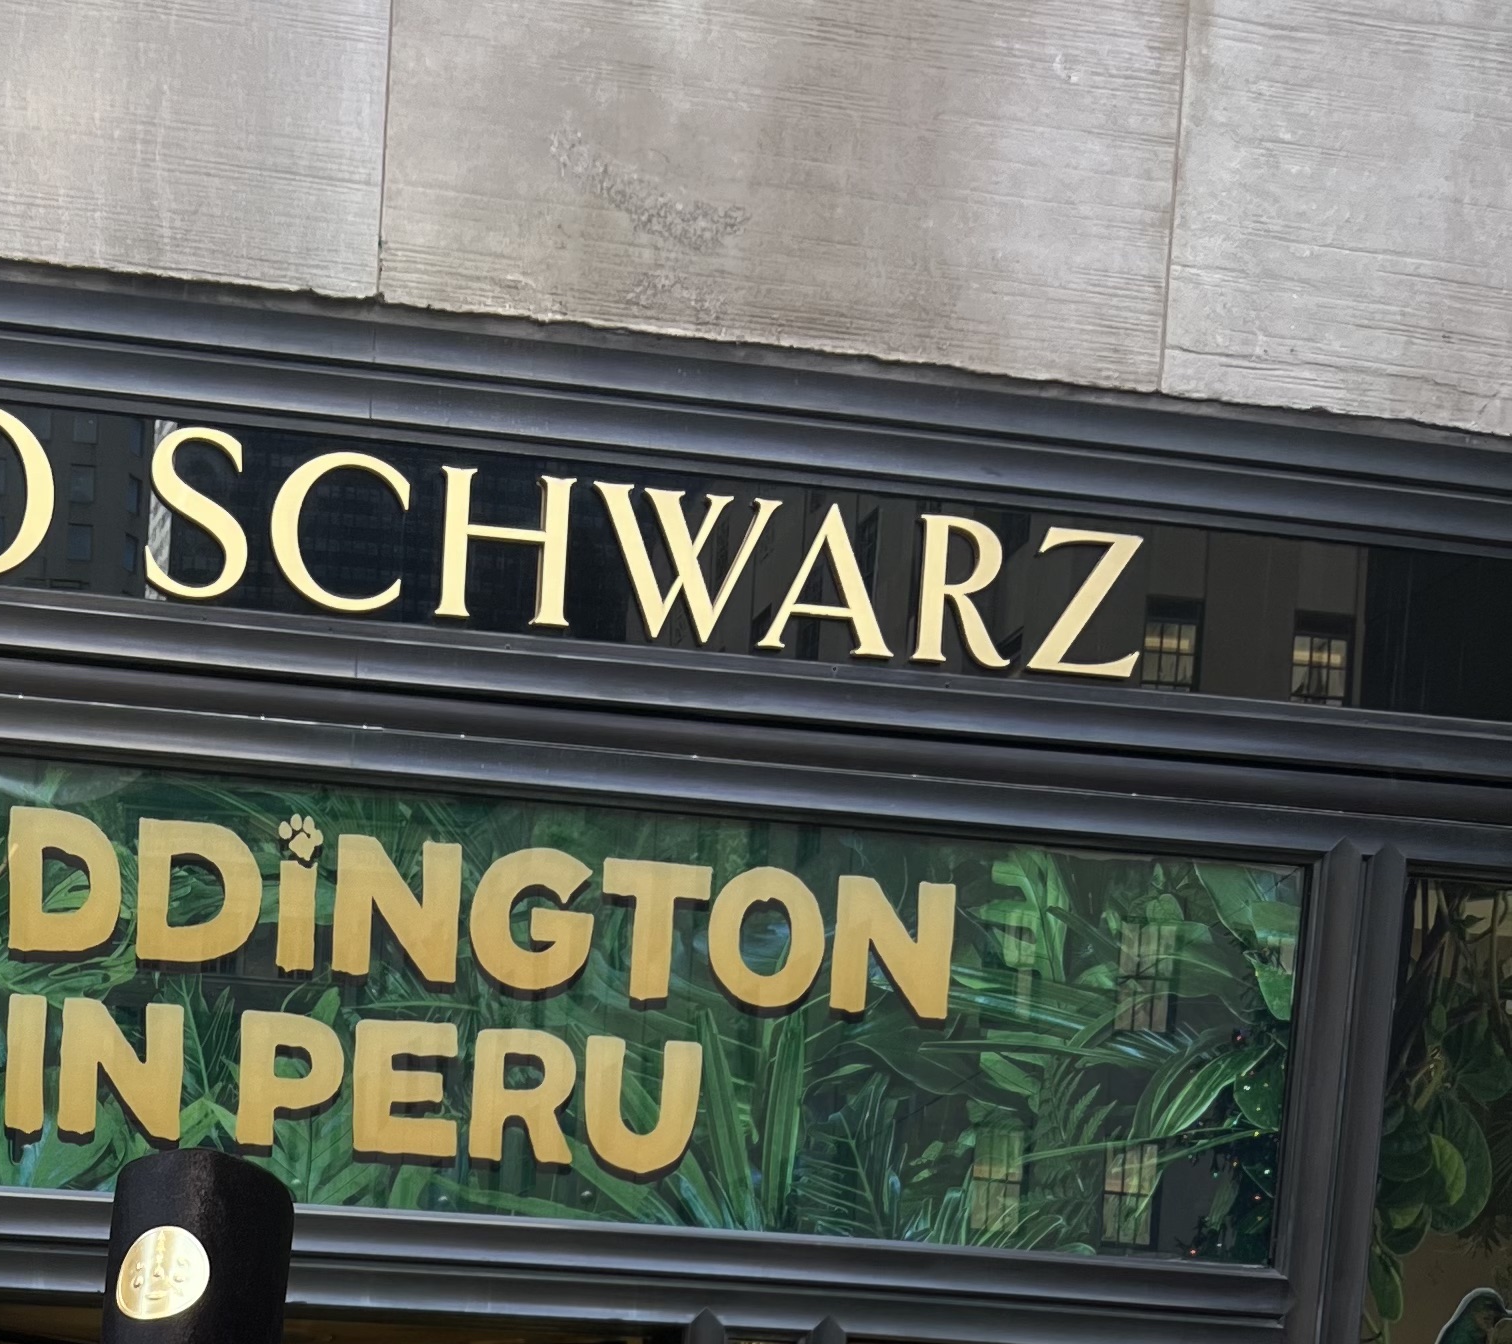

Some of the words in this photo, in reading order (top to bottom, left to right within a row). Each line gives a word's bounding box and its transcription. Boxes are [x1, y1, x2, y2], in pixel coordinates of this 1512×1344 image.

[144, 426, 1145, 679] SCHWARZ
[4, 994, 184, 1142] IN
[236, 1009, 702, 1175] PERU
